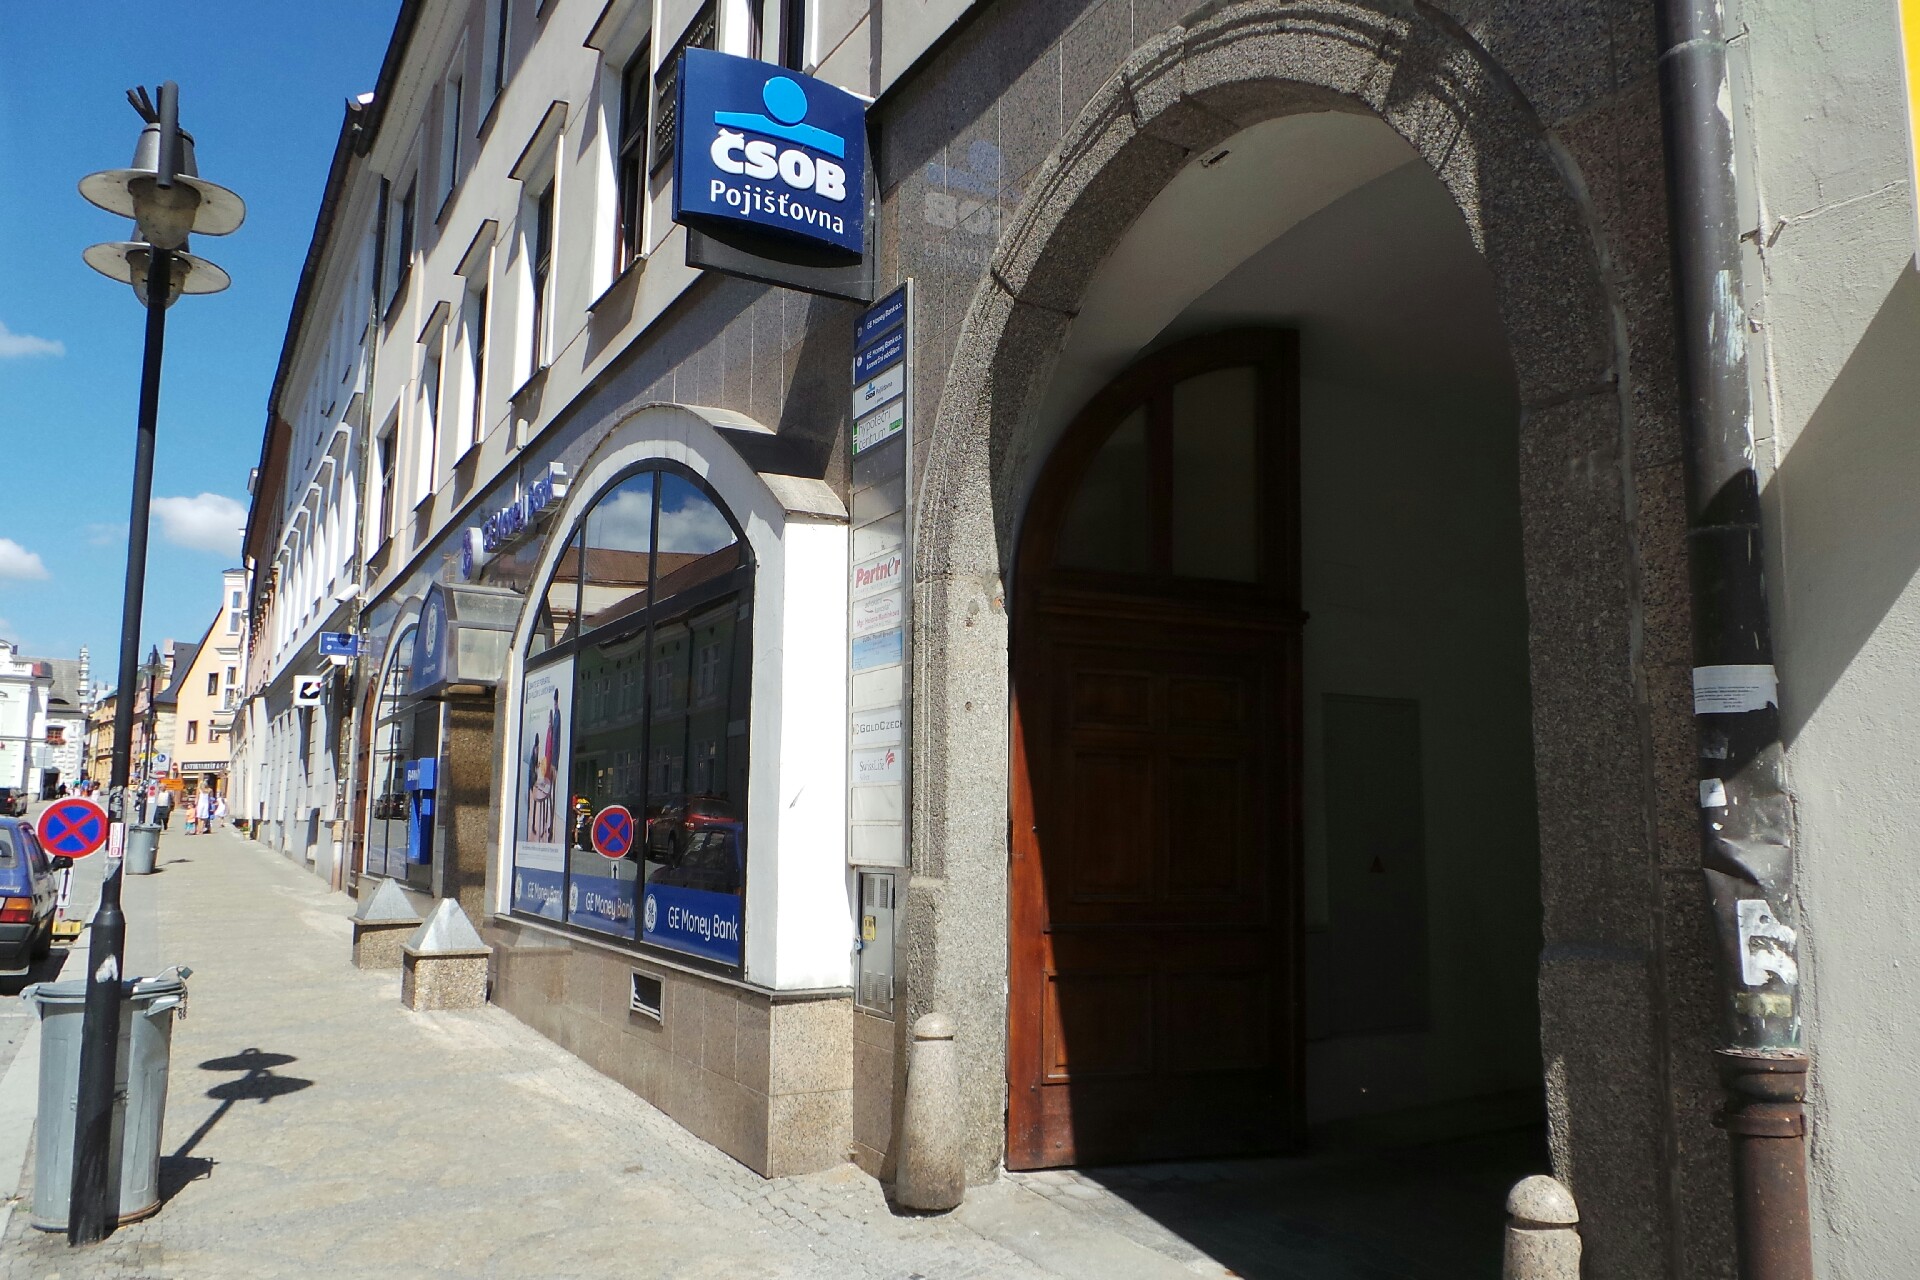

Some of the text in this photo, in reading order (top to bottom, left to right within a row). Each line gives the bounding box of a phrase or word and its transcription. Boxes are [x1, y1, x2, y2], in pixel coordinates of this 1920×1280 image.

[710, 128, 846, 202] ČSOB
[710, 180, 845, 235] Pojišťovna
[858, 427, 886, 450] centrum
[855, 556, 901, 588] Partner
[535, 883, 549, 905] Money
[585, 892, 635, 920] GE Money Bank
[668, 906, 738, 942] GE Money Bank
